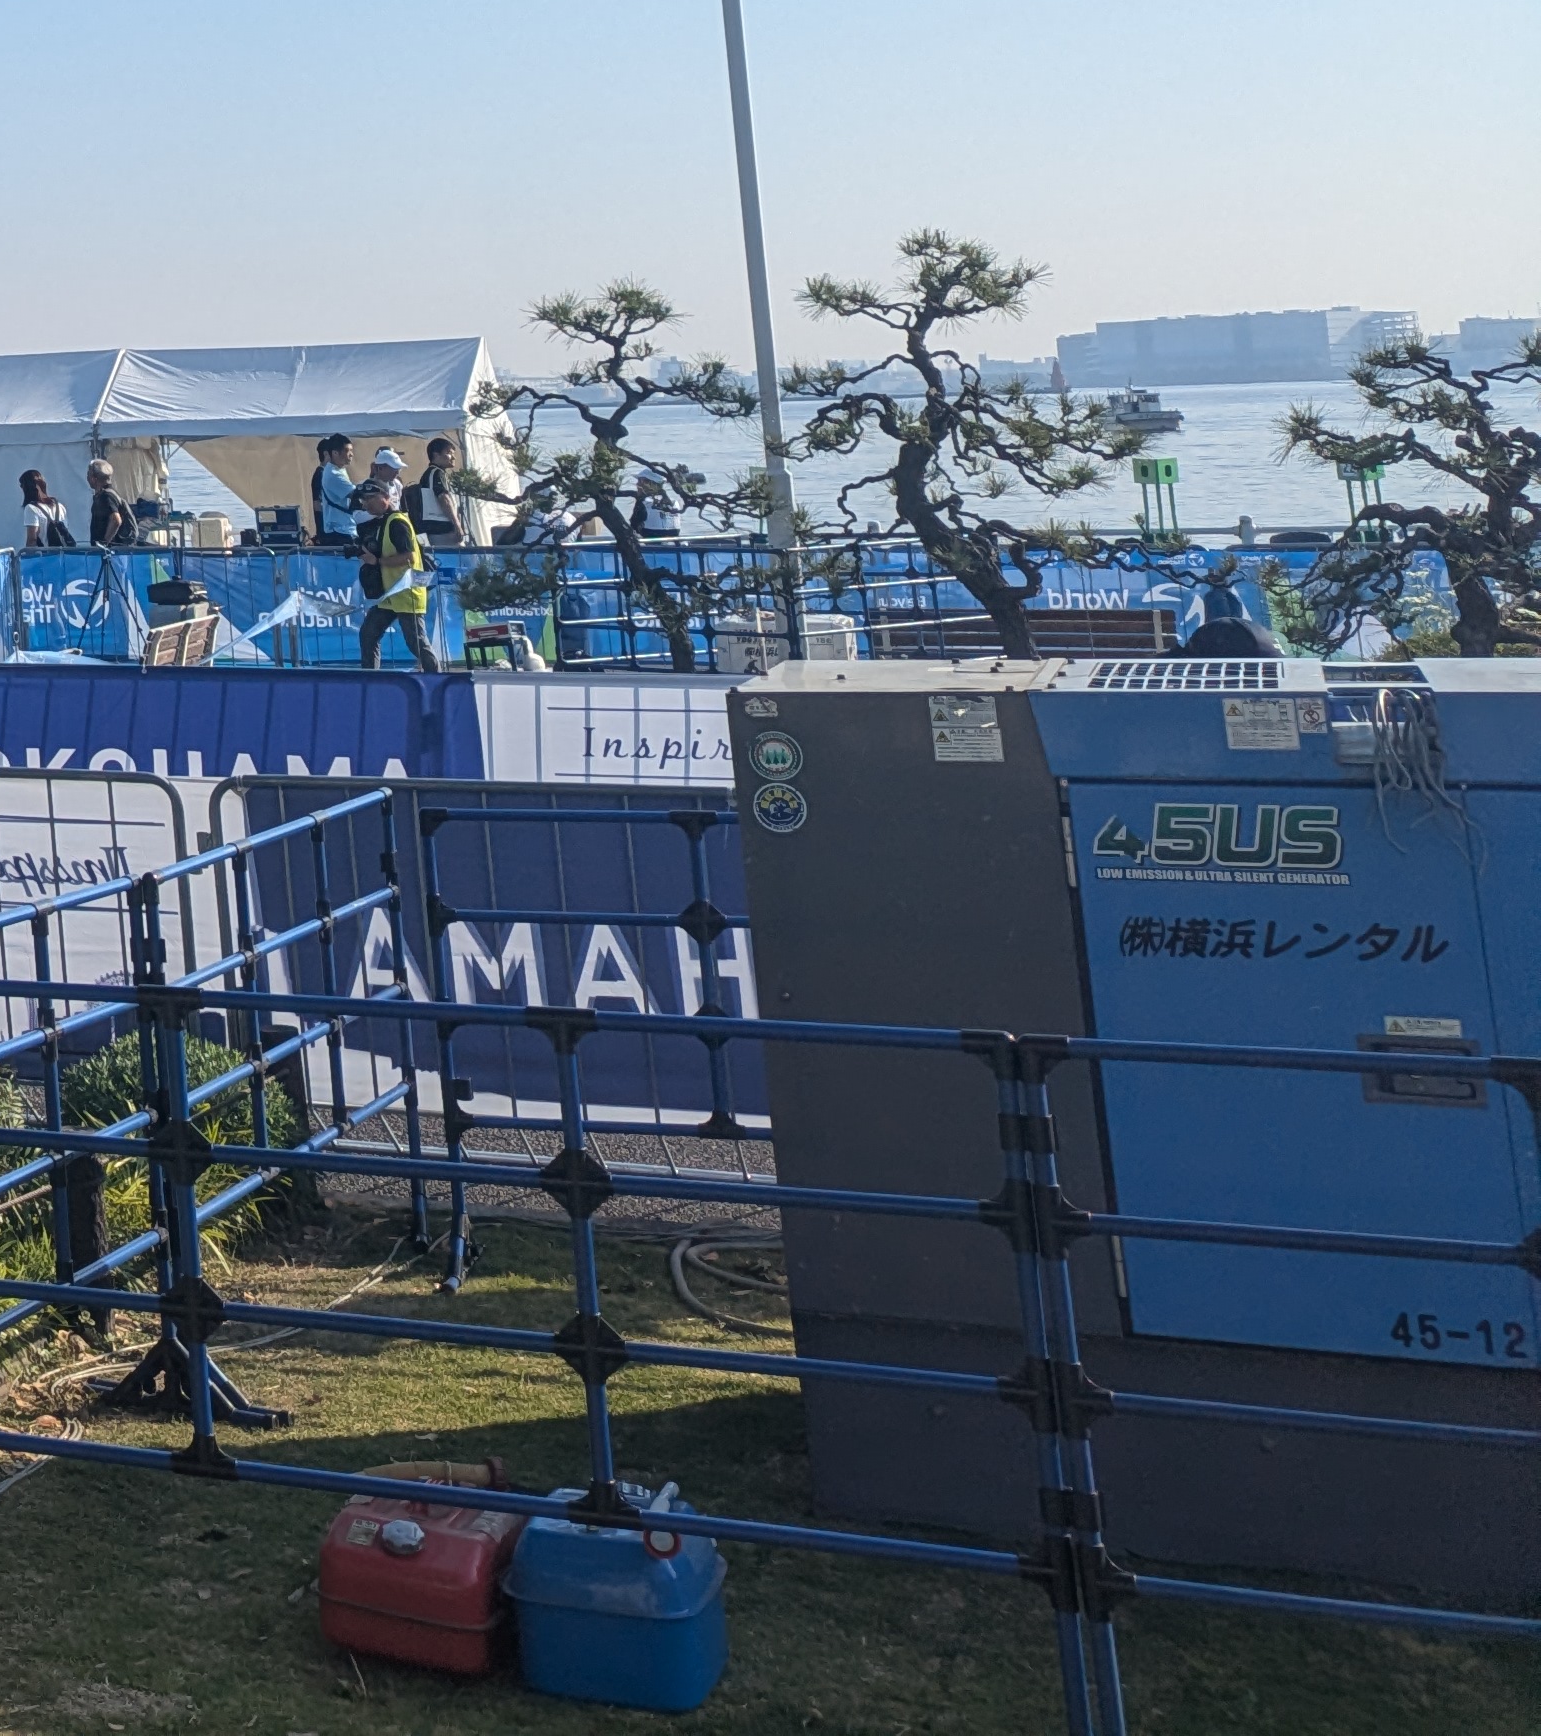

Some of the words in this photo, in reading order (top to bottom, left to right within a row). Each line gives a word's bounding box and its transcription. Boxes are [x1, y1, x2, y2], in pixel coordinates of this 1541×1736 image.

[582, 726, 732, 771] Inspir
[1096, 867, 1123, 879] LOW
[1234, 872, 1275, 883] SILENT
[1277, 873, 1350, 885] GENERATOR
[1390, 1311, 1528, 1359] 45-12
